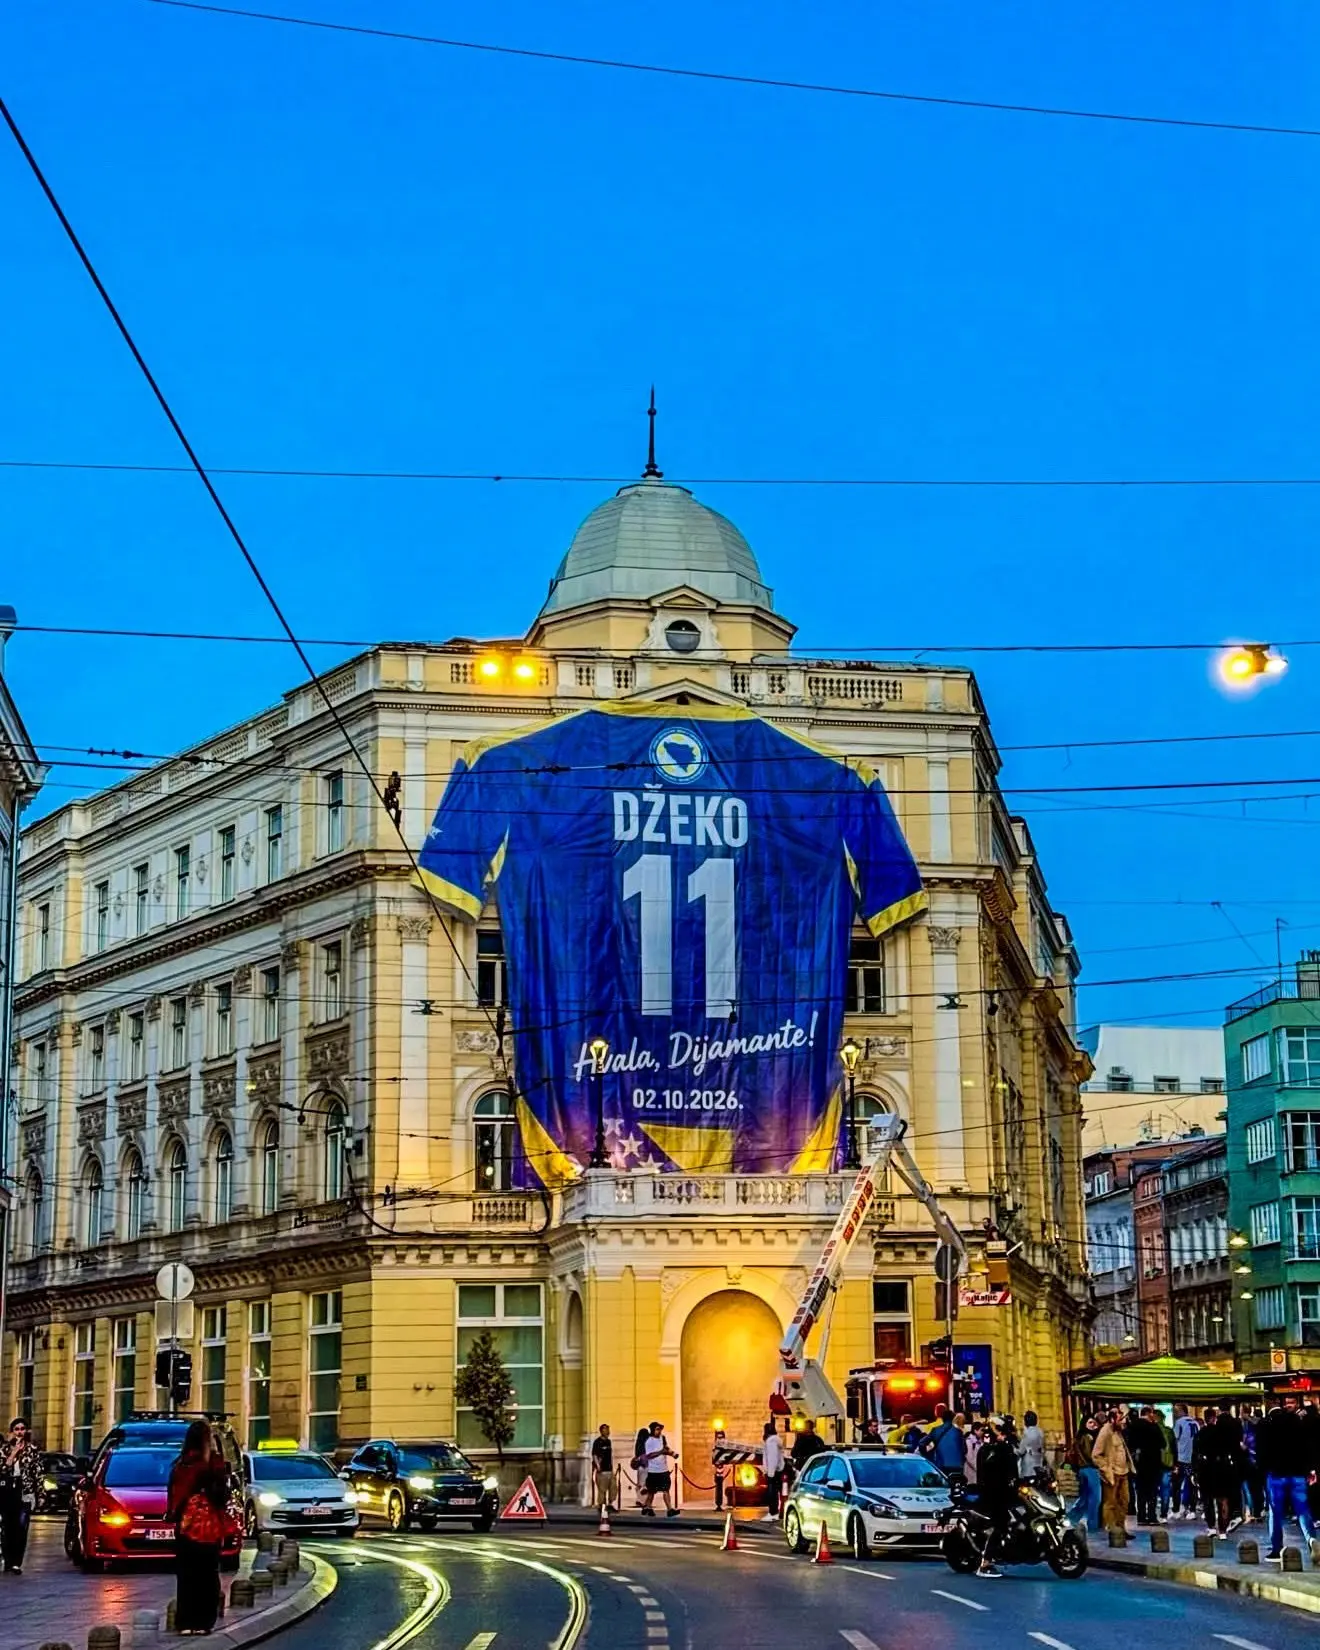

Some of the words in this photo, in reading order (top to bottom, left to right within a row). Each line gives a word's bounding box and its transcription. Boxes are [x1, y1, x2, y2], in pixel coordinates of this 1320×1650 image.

[612, 783, 749, 848] DŽEKO
[622, 854, 737, 1019] 11
[667, 1010, 819, 1077] Dijamante!
[632, 1088, 744, 1110] 02.10.2026.
